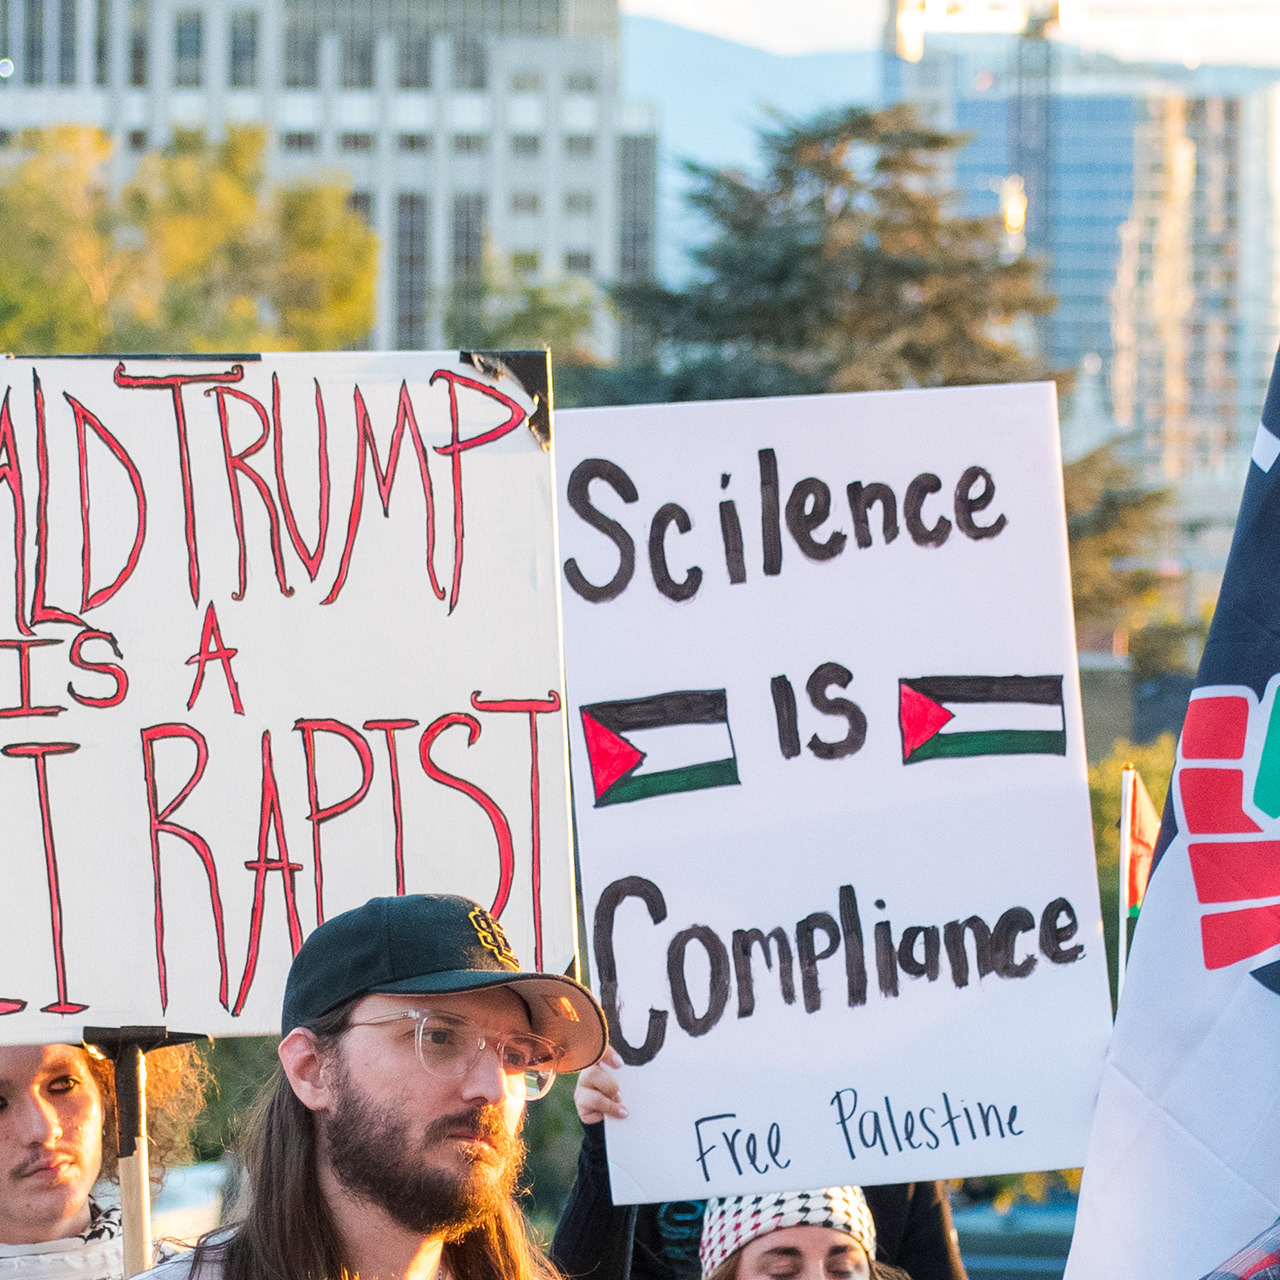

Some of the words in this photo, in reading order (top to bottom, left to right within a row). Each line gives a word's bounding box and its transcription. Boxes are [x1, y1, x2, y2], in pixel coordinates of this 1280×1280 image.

[114, 363, 527, 616] TRUMP
[563, 448, 1008, 604] Scilence
[185, 601, 245, 715] A
[770, 662, 867, 760] IS
[141, 690, 562, 1016] RAPIST
[593, 875, 1086, 1067] Compliance
[694, 1112, 791, 1182] Free
[830, 1087, 1024, 1162] Palestine
